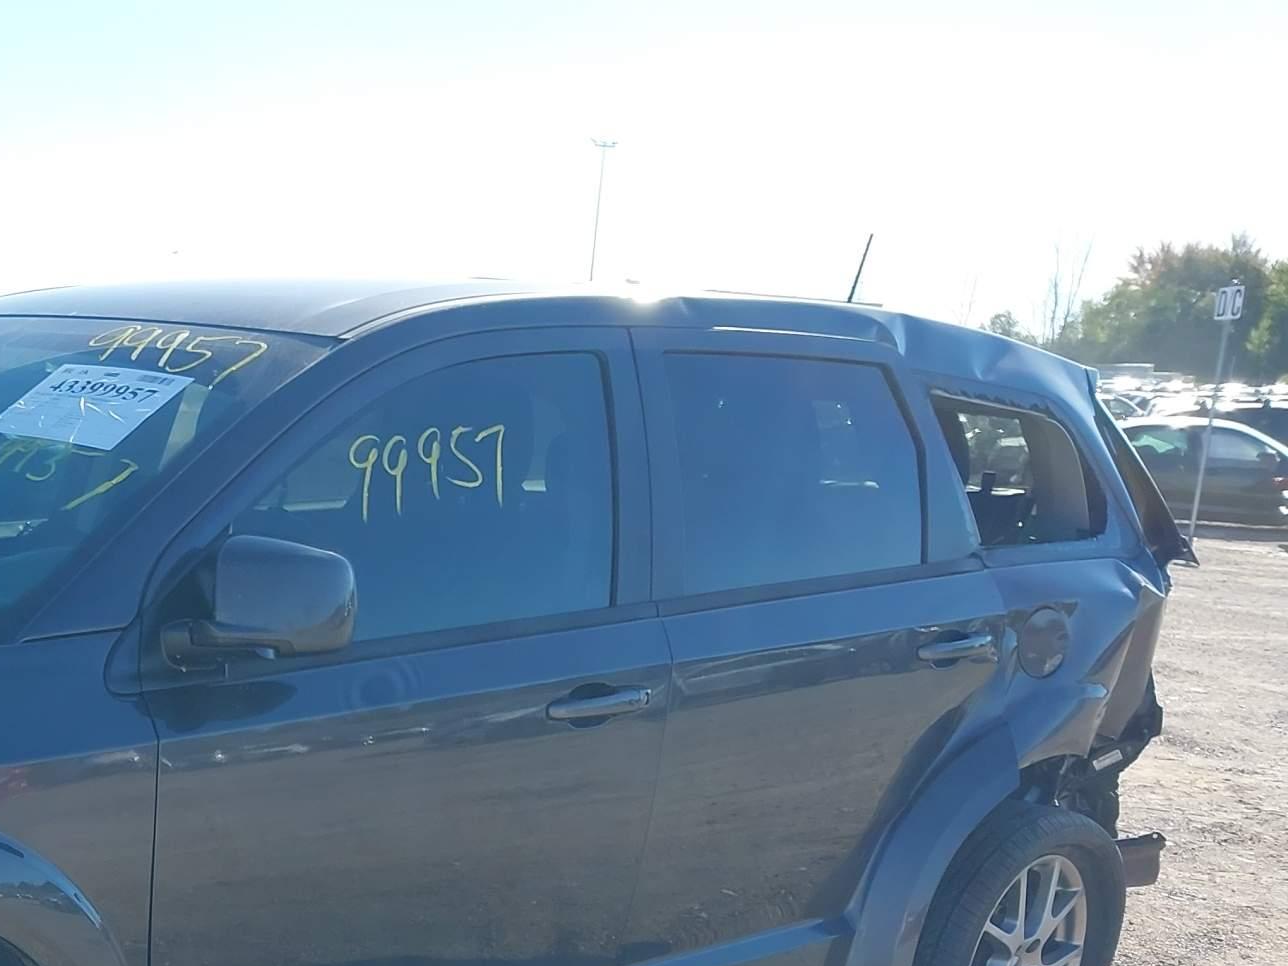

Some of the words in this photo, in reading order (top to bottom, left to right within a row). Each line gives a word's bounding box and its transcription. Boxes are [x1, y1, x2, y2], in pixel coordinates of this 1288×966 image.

[49, 377, 160, 403] 43399957
[89, 325, 268, 390] 99957
[348, 424, 505, 524] 99957
